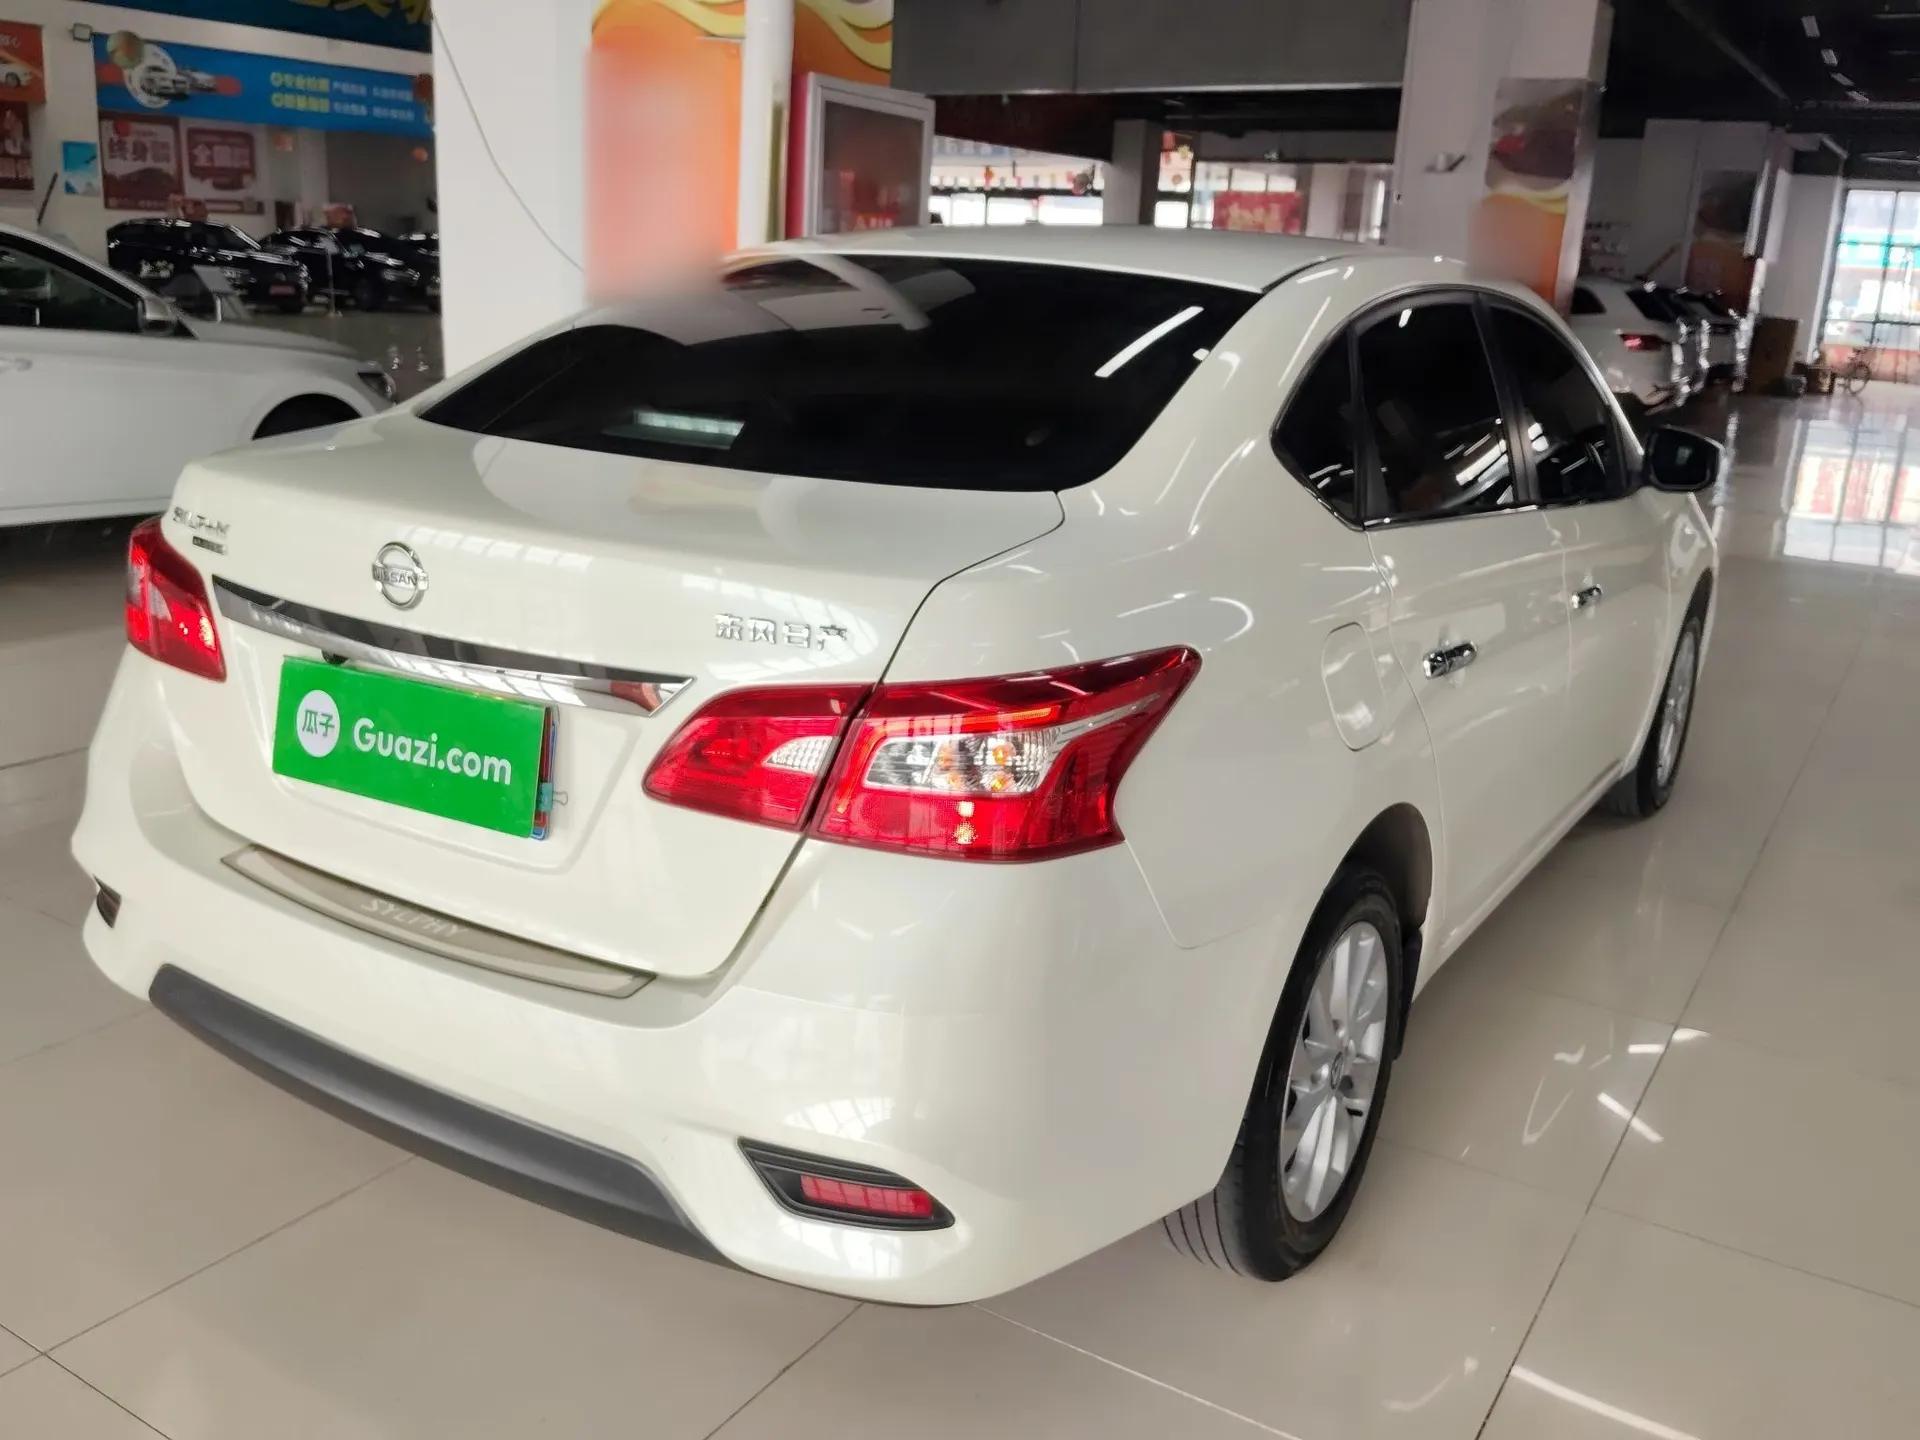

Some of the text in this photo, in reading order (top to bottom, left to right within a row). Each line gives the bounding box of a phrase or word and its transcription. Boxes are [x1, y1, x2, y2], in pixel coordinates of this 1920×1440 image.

[374, 565, 418, 586] NISSAN
[715, 612, 848, 651] 东风日产
[301, 709, 336, 738] 瓜子
[353, 717, 513, 786] Guazi.com
